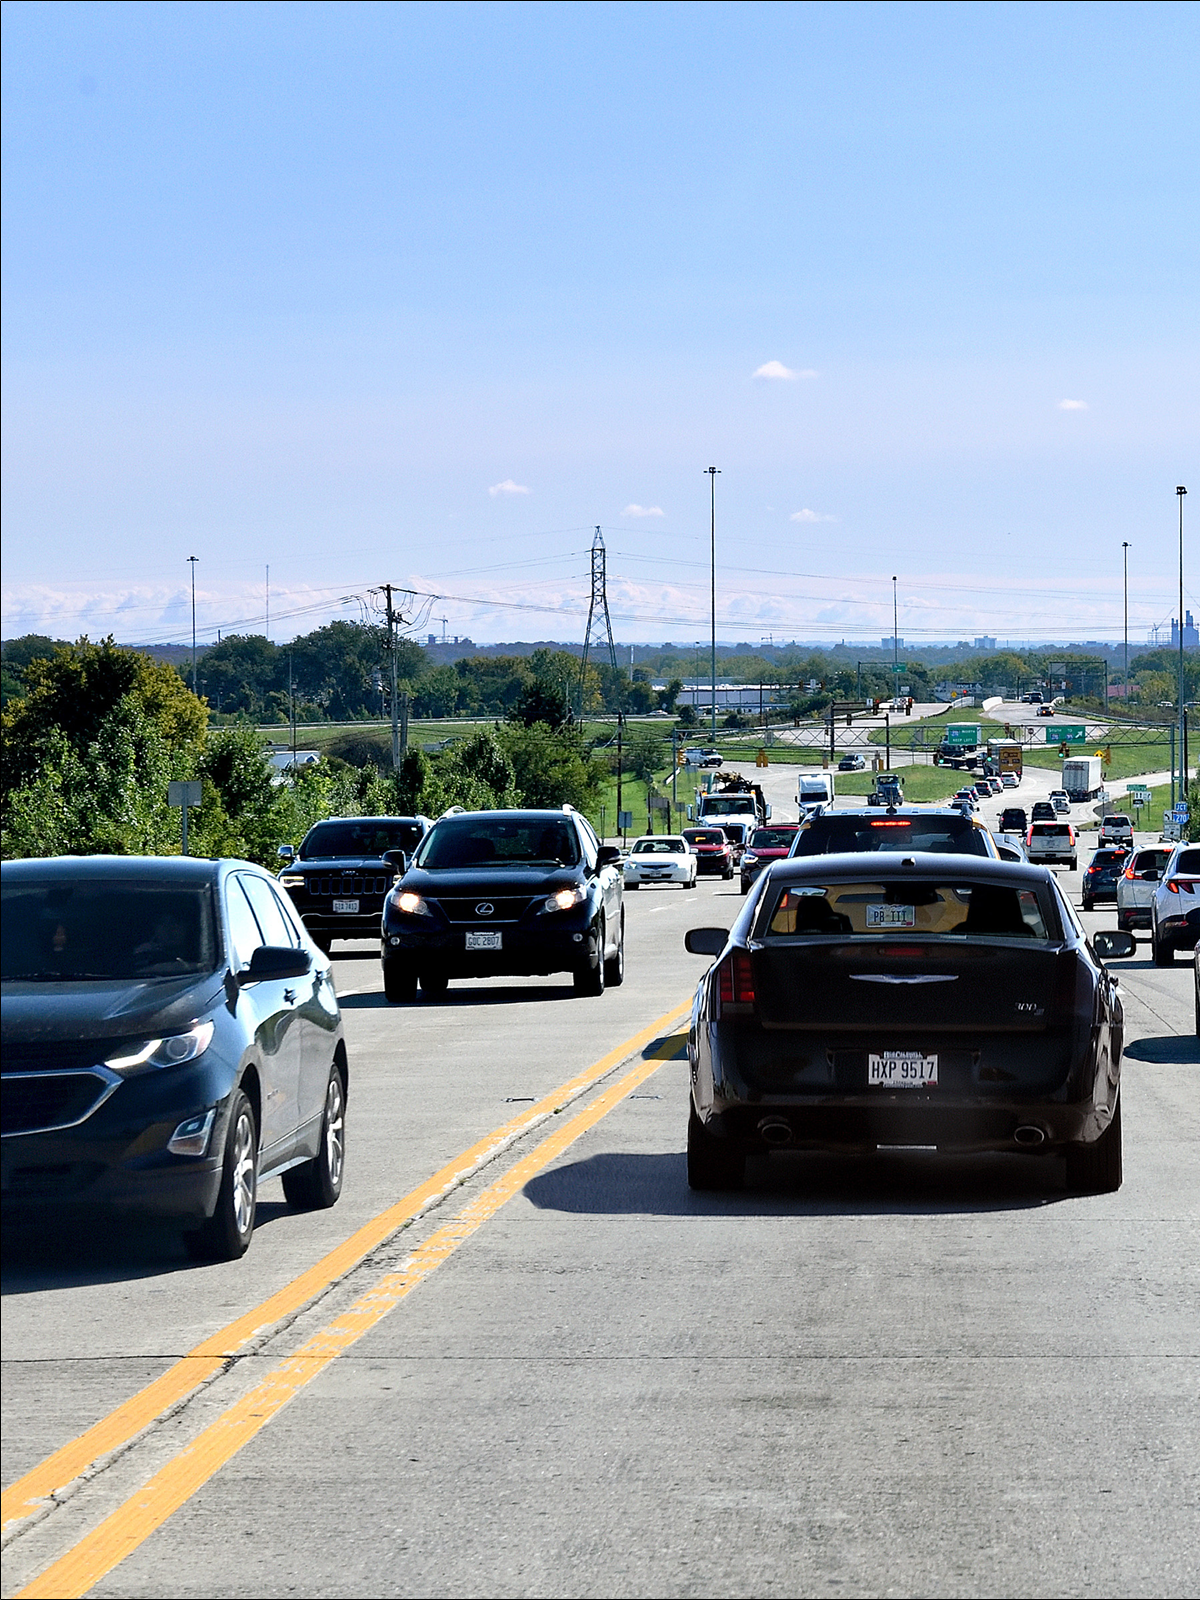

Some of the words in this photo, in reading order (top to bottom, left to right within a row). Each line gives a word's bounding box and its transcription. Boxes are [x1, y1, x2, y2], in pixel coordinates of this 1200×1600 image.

[1176, 814, 1187, 822] 270
[872, 1060, 897, 1079] HXP
[901, 1060, 935, 1079] 9517
